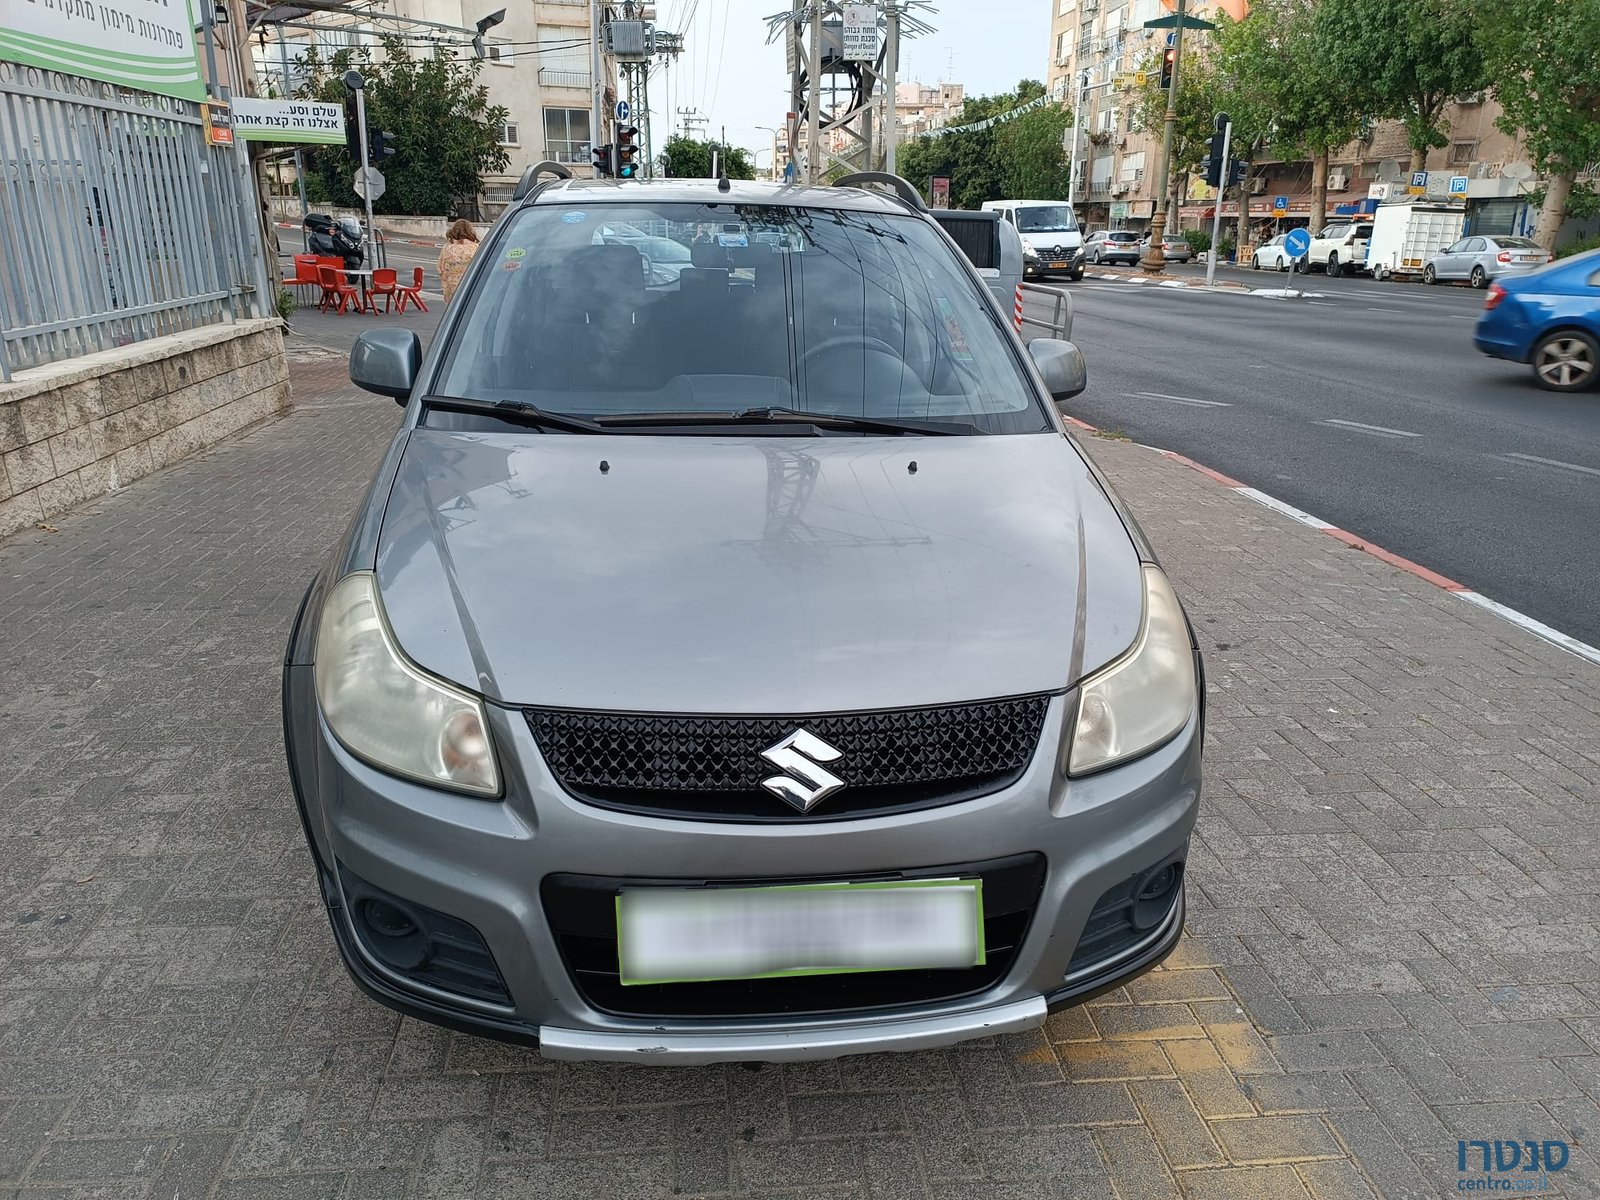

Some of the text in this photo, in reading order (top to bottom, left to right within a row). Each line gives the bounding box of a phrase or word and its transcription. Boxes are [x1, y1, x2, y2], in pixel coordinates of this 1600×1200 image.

[99, 5, 135, 34] מימון
[138, 18, 184, 49] פתרונות
[279, 105, 337, 117] שלם וסע...
[265, 115, 289, 128] קצת
[293, 117, 305, 127] זה
[308, 117, 339, 129] אצלנו
